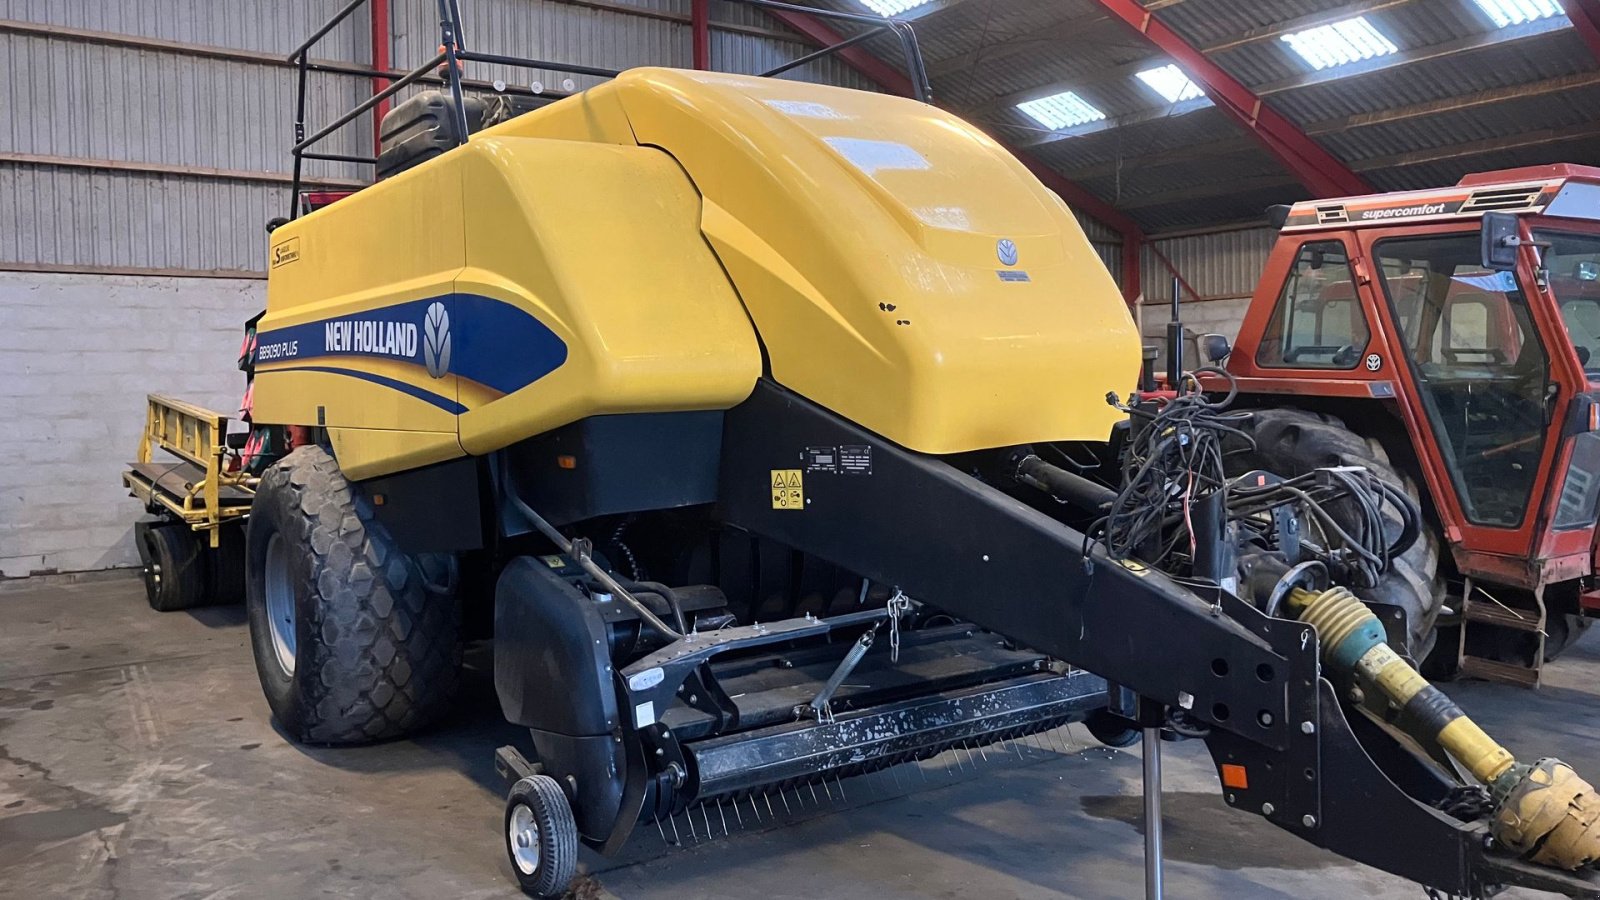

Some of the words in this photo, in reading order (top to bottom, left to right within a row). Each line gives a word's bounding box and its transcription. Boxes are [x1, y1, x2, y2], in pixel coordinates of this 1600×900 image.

[1362, 203, 1445, 219] supercomfort
[325, 321, 352, 351] NEW
[354, 320, 418, 358] HOLLAND
[258, 343, 281, 360] BB9090
[281, 341, 298, 357] PLUS
